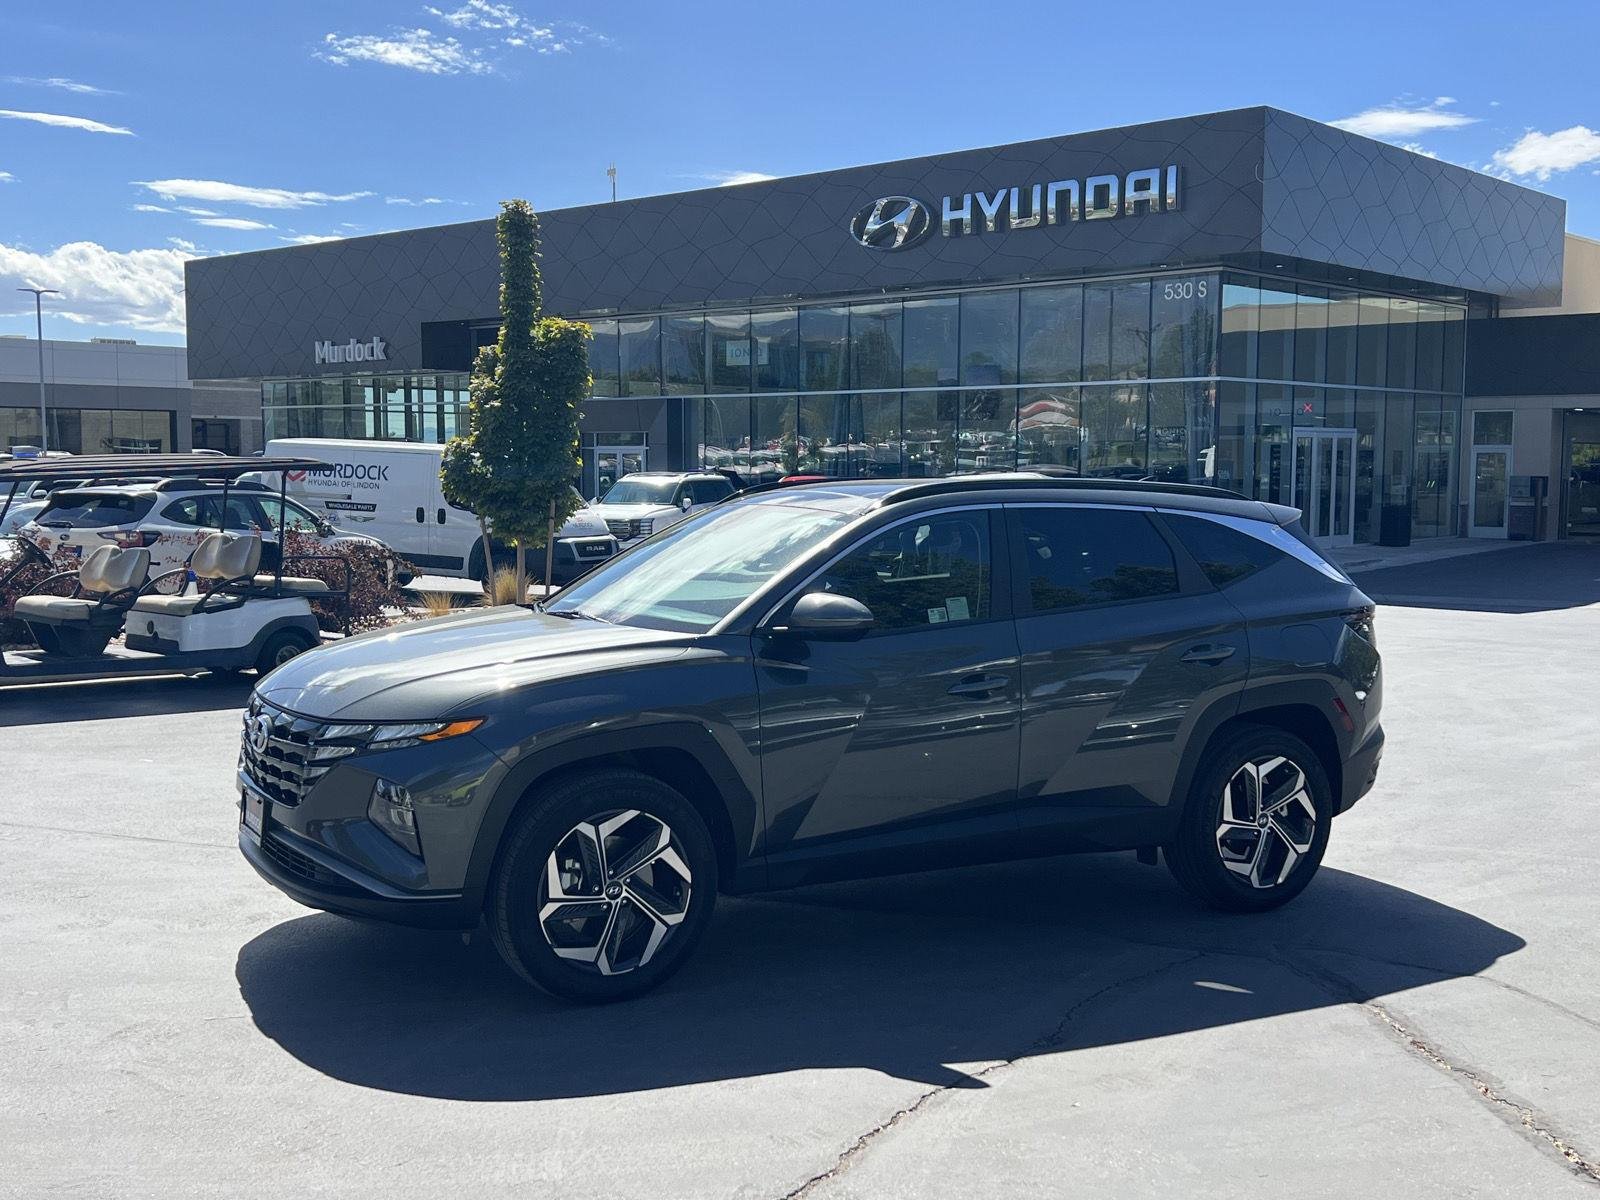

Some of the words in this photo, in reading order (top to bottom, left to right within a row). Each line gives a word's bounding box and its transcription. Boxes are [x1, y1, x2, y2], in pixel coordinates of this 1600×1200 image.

[941, 164, 1179, 237] HYUNDAI
[1164, 281, 1193, 300] 530
[1197, 280, 1207, 298] S
[314, 336, 387, 364] Murdock
[308, 479, 339, 487] HYUNDAI
[353, 482, 380, 490] LINDON
